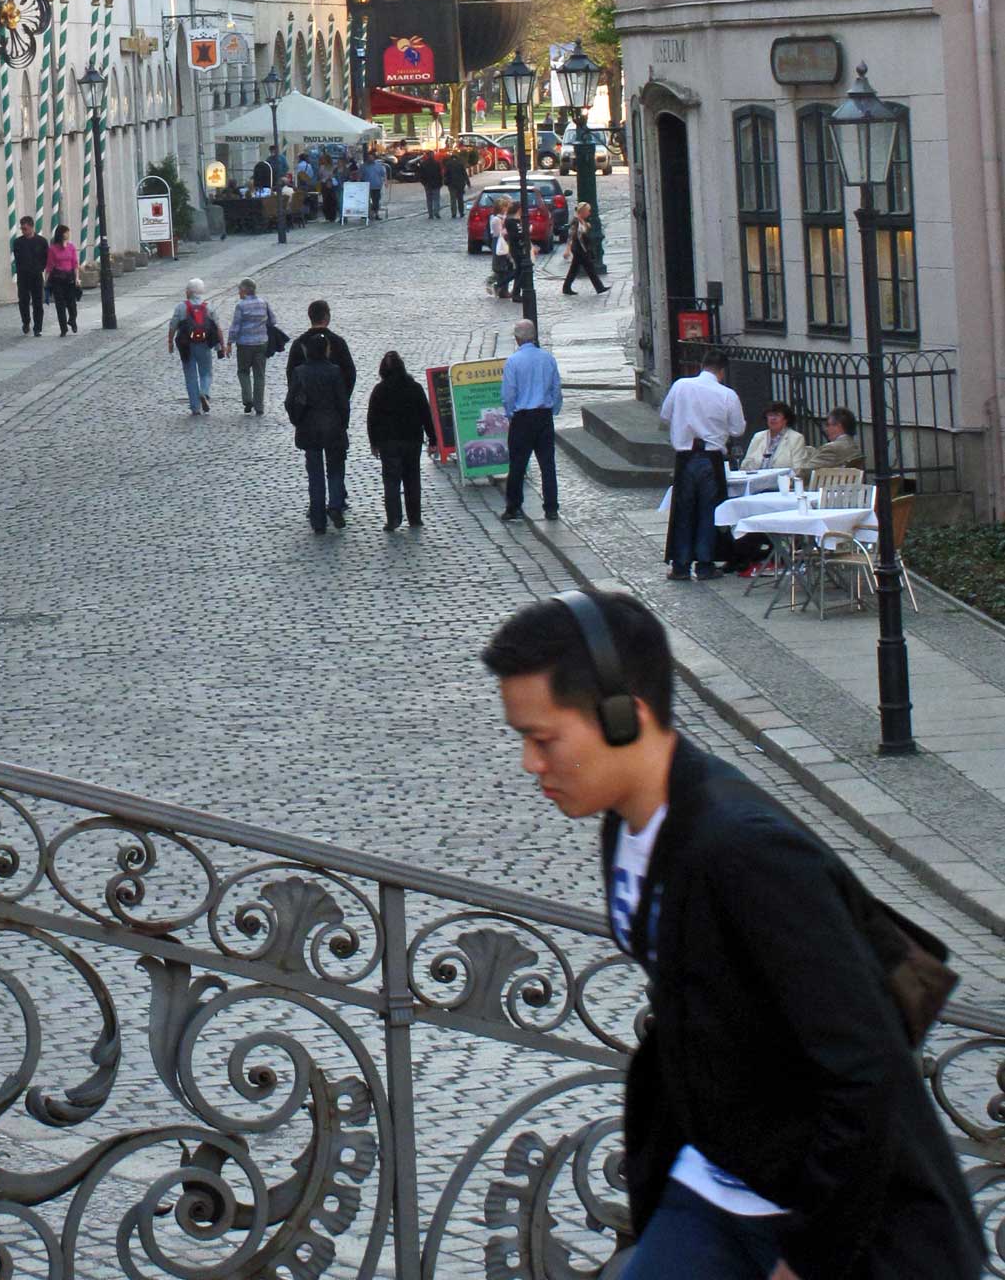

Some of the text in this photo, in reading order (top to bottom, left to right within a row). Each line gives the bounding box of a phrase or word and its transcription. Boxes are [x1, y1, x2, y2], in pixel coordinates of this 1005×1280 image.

[386, 73, 431, 81] MAREDO
[225, 135, 266, 143] PAULANER
[303, 135, 345, 143] PAULANER
